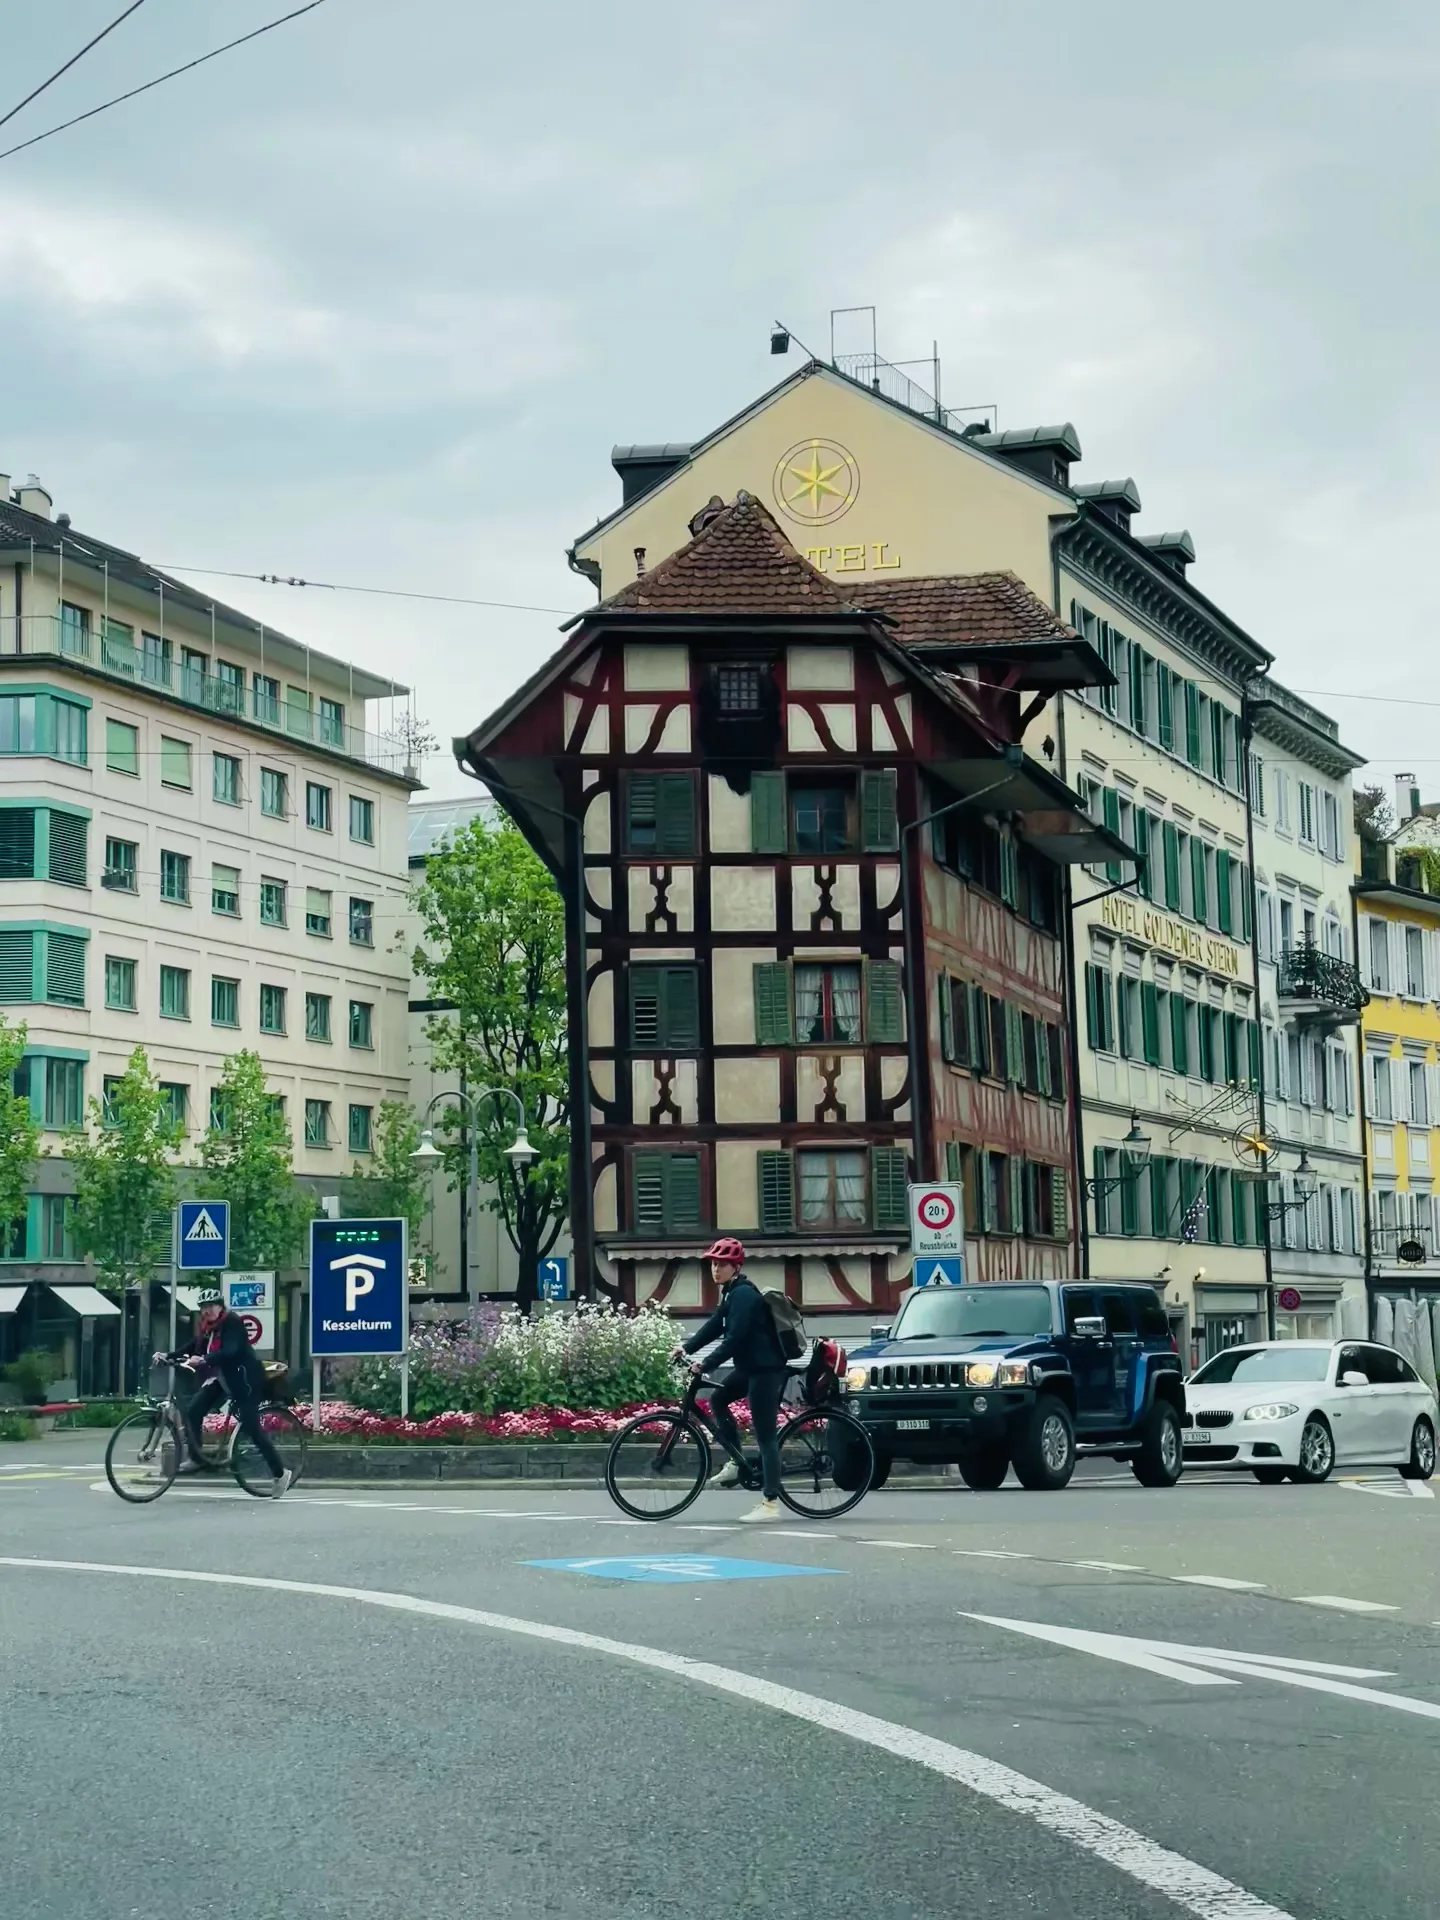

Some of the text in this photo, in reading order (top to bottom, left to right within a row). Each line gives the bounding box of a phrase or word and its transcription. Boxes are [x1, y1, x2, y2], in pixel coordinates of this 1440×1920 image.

[1102, 895, 1239, 976] HOTEL GOLDENER STERN
[928, 1205, 940, 1216] 20
[934, 1232, 942, 1240] ab
[919, 1241, 958, 1250] Reussbrücke
[346, 1268, 375, 1311] P
[322, 1319, 392, 1331] Kesselturm
